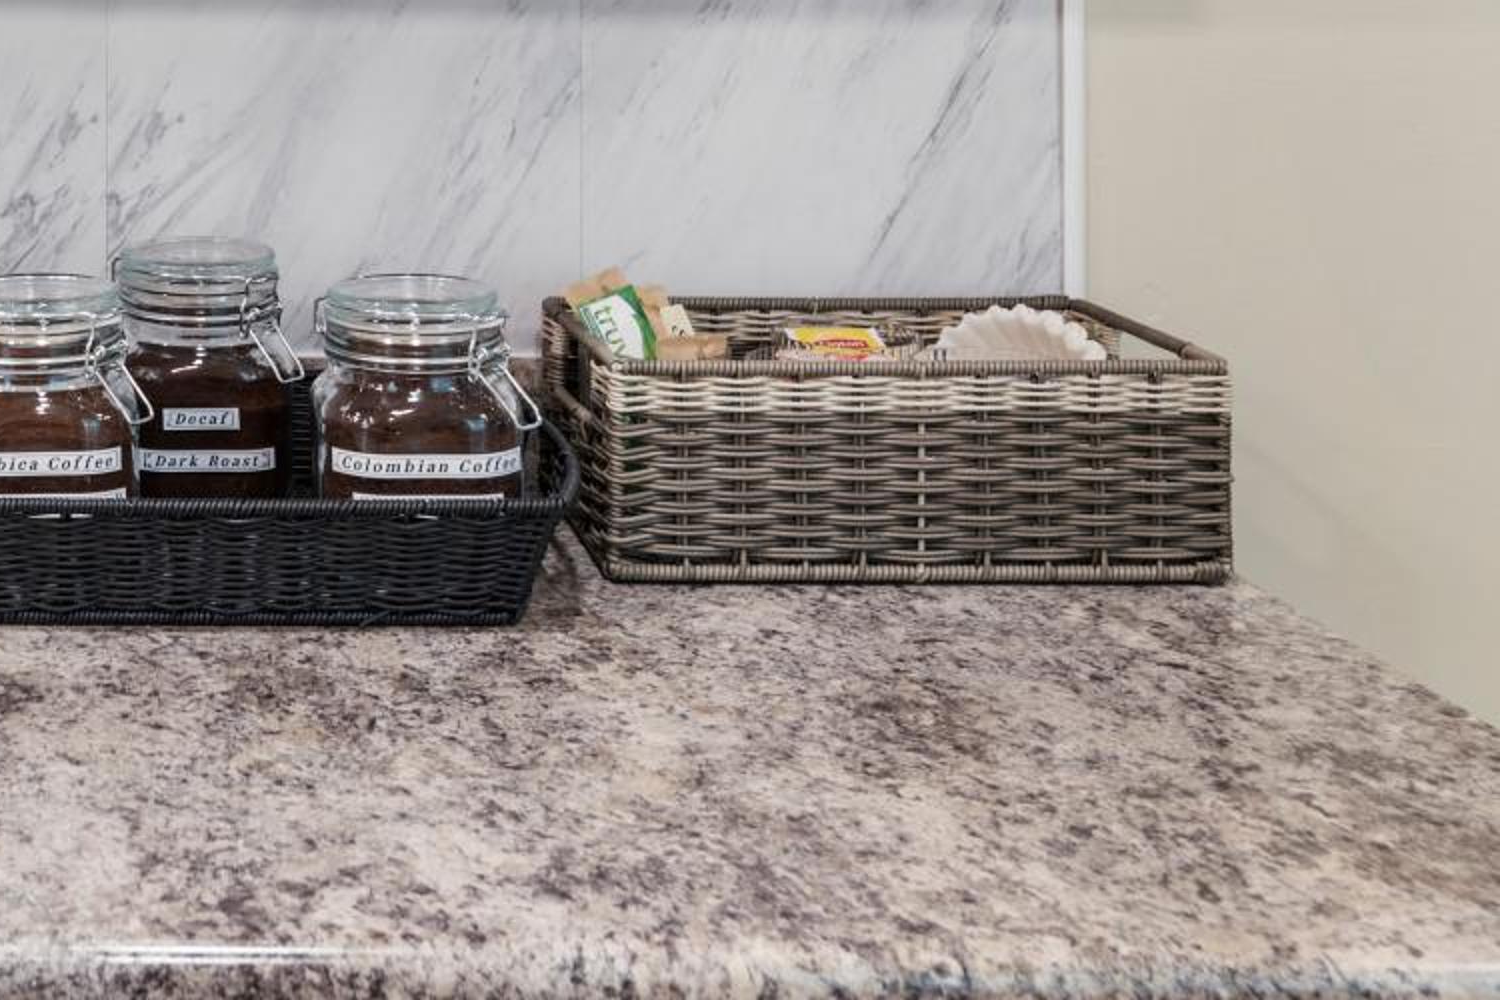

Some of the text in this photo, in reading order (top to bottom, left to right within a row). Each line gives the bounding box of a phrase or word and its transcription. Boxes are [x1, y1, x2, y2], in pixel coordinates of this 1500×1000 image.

[174, 410, 230, 426] Decaf
[47, 454, 115, 472] Coffee
[155, 454, 260, 468] Dark Roast
[341, 454, 518, 474] Colombian Coffee
